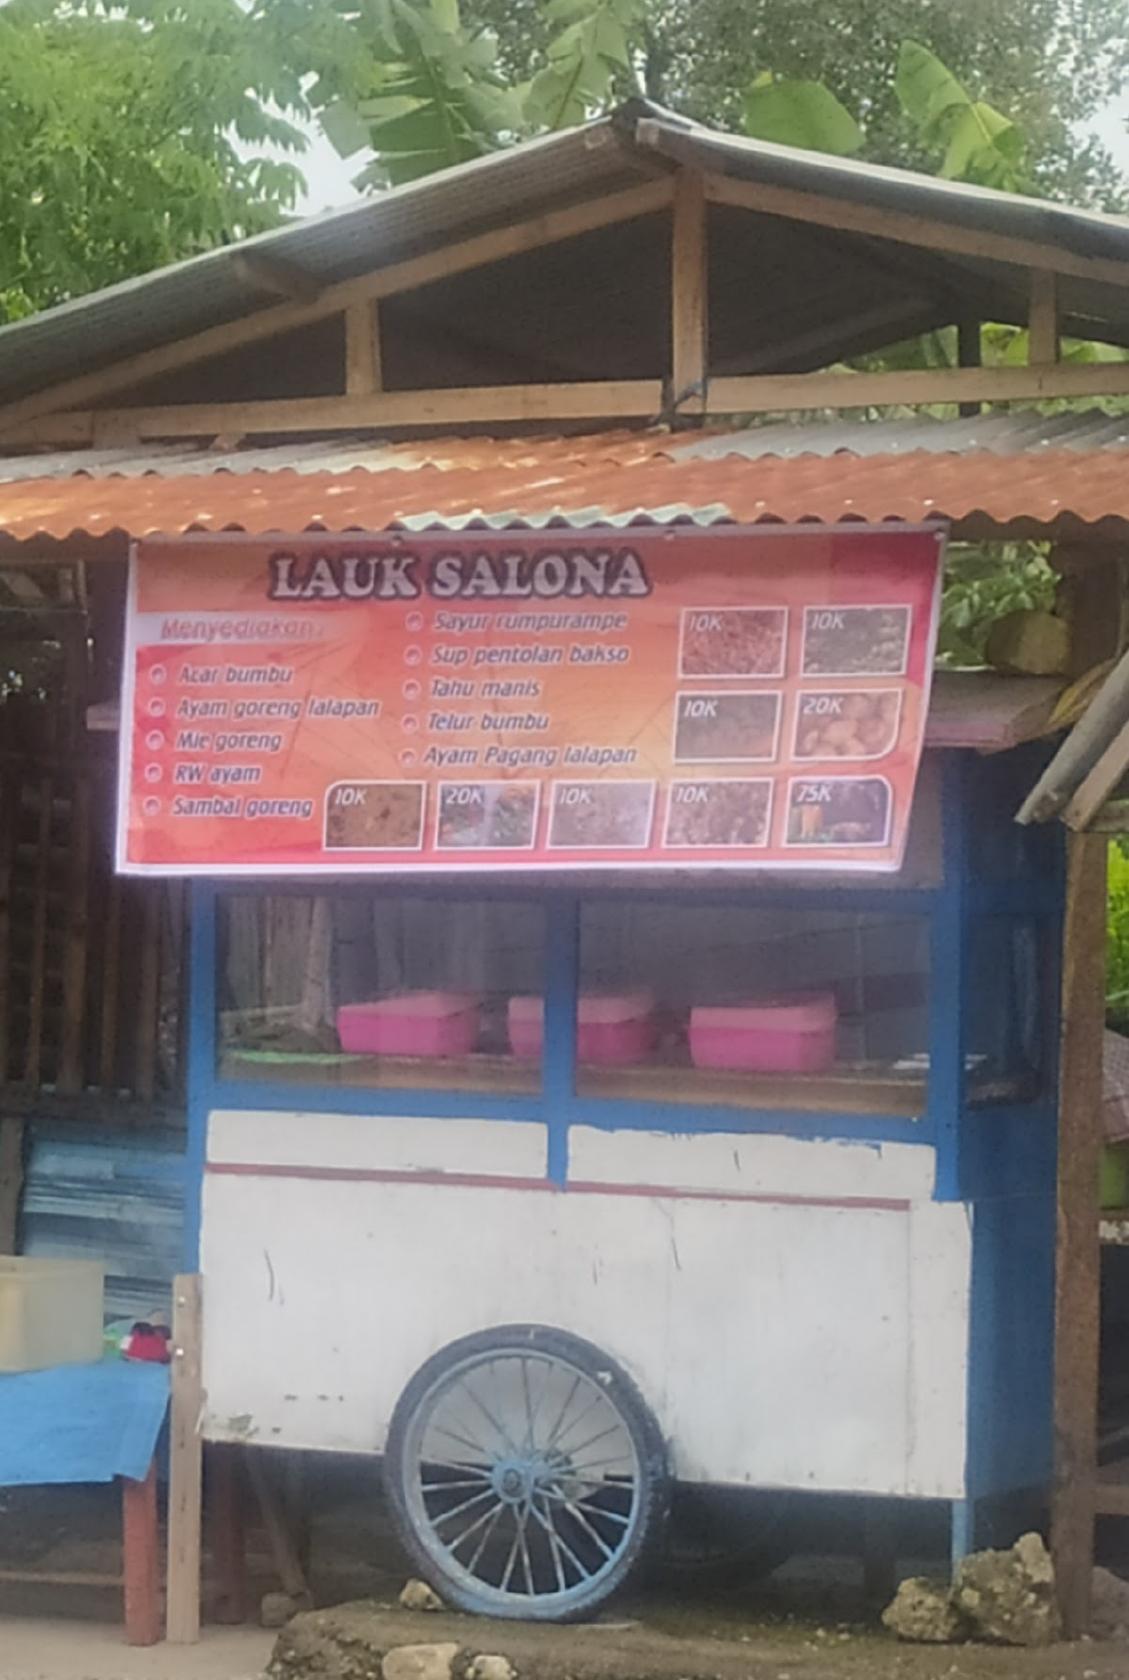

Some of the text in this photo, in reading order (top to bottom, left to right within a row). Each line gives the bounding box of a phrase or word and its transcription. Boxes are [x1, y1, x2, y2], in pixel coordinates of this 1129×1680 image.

[271, 553, 651, 598] LAUK SALONA
[435, 613, 489, 631] Sayur
[690, 615, 722, 631] 10K
[812, 612, 845, 629] 10K
[433, 646, 629, 664] Sup pentolan bakso
[179, 666, 292, 682] Acar bumbu
[432, 681, 540, 697] Tahu manis
[177, 698, 378, 718] Ayam goreng lalapan
[684, 700, 718, 717] 10K
[803, 698, 843, 714] 20K
[429, 713, 548, 730] Telur bumbu
[177, 732, 282, 751] Mie goreng
[425, 747, 477, 765] Ayam
[564, 747, 636, 765] lalapan
[175, 765, 260, 782] RW ayam
[335, 788, 367, 805] 10K
[446, 788, 484, 804] 20K
[560, 788, 594, 804] 10K
[675, 786, 710, 802] 10K
[173, 798, 312, 817] Sambal goreng
